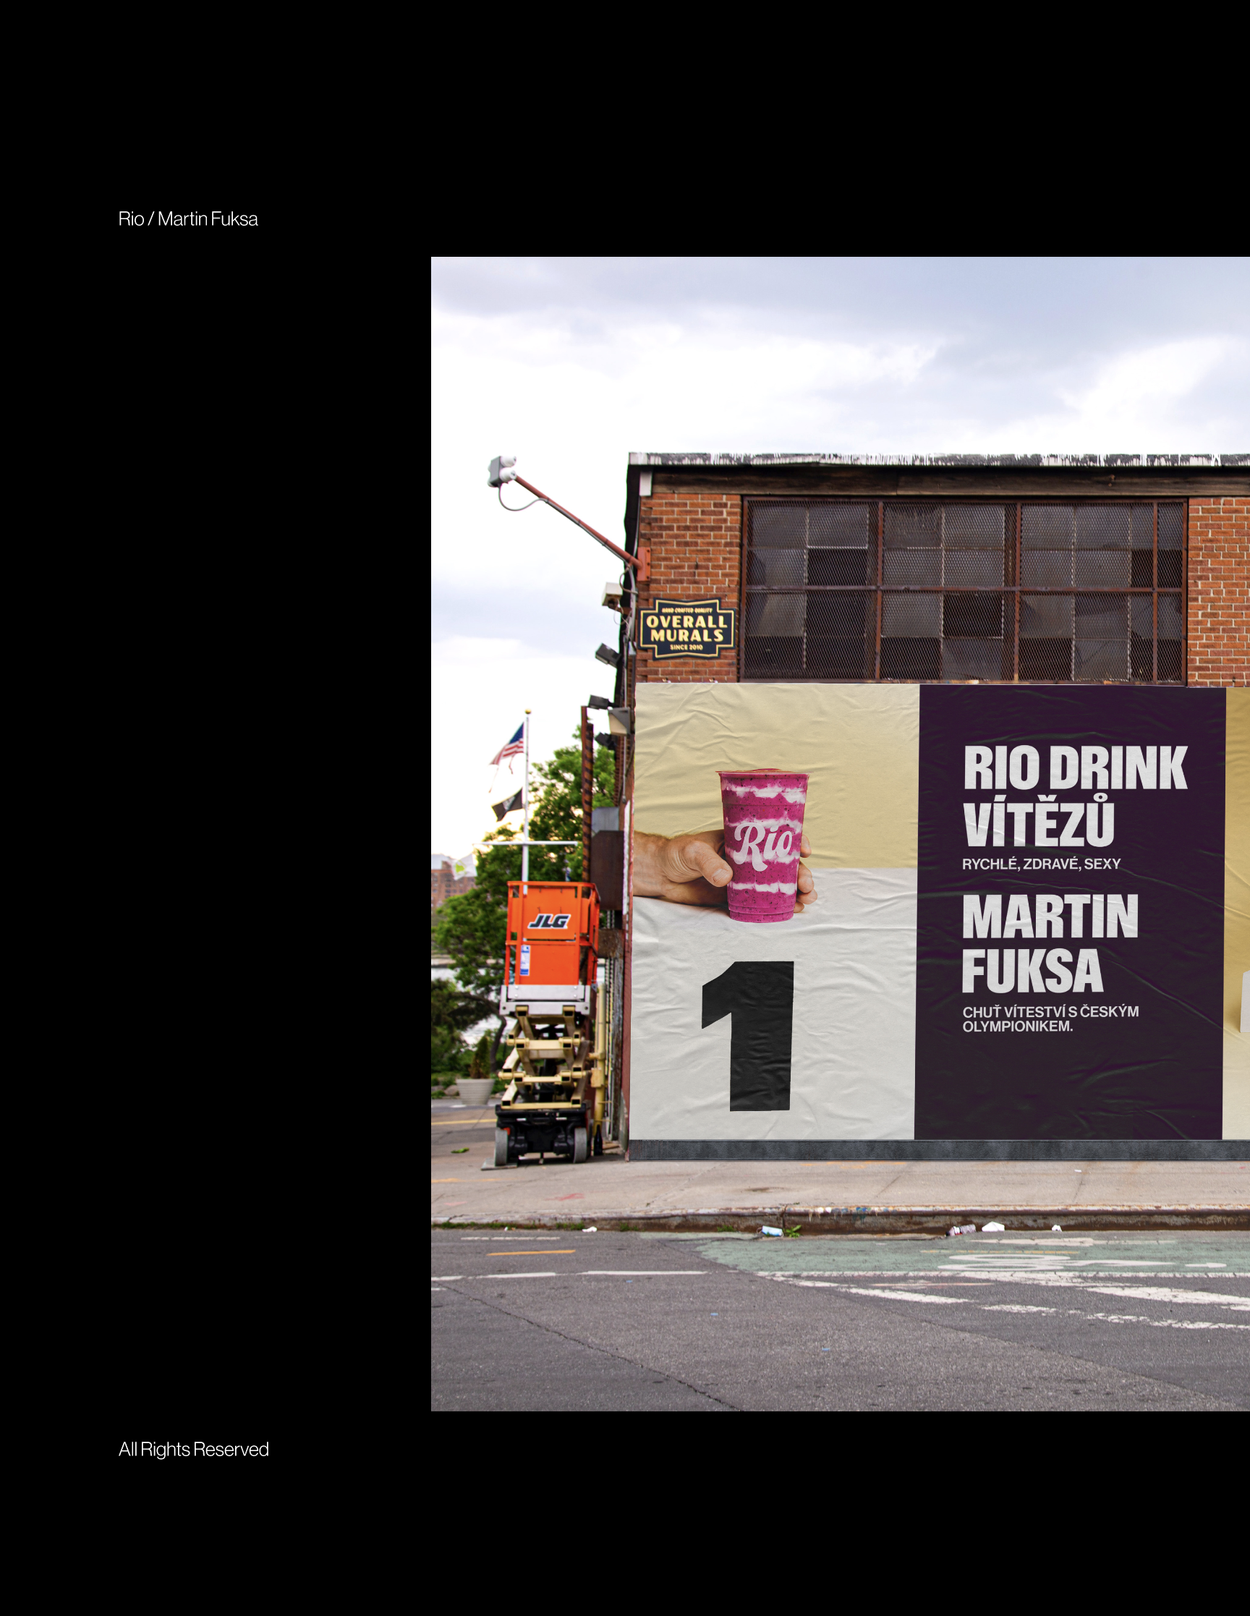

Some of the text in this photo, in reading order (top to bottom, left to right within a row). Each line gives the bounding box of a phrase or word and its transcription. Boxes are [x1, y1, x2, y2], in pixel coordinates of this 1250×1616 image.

[646, 615, 728, 628] OVERALL
[650, 629, 724, 642] MURALS
[964, 744, 1189, 790] RIO DRINK
[962, 792, 1115, 848] VÍTĚZŮ
[734, 822, 793, 871] Rio
[962, 856, 1122, 871] RYCHLÉ, ZDRAVÉ, SEXY
[527, 913, 571, 929] JLG
[962, 893, 1139, 939] MARTIN
[962, 947, 1104, 994] FUKSA
[962, 1003, 1139, 1019] CHUŤ VÍTESTVÍ S ČESKÝM
[962, 1020, 1074, 1033] OLYMPIONIKEM.
[702, 961, 794, 1112] 1
